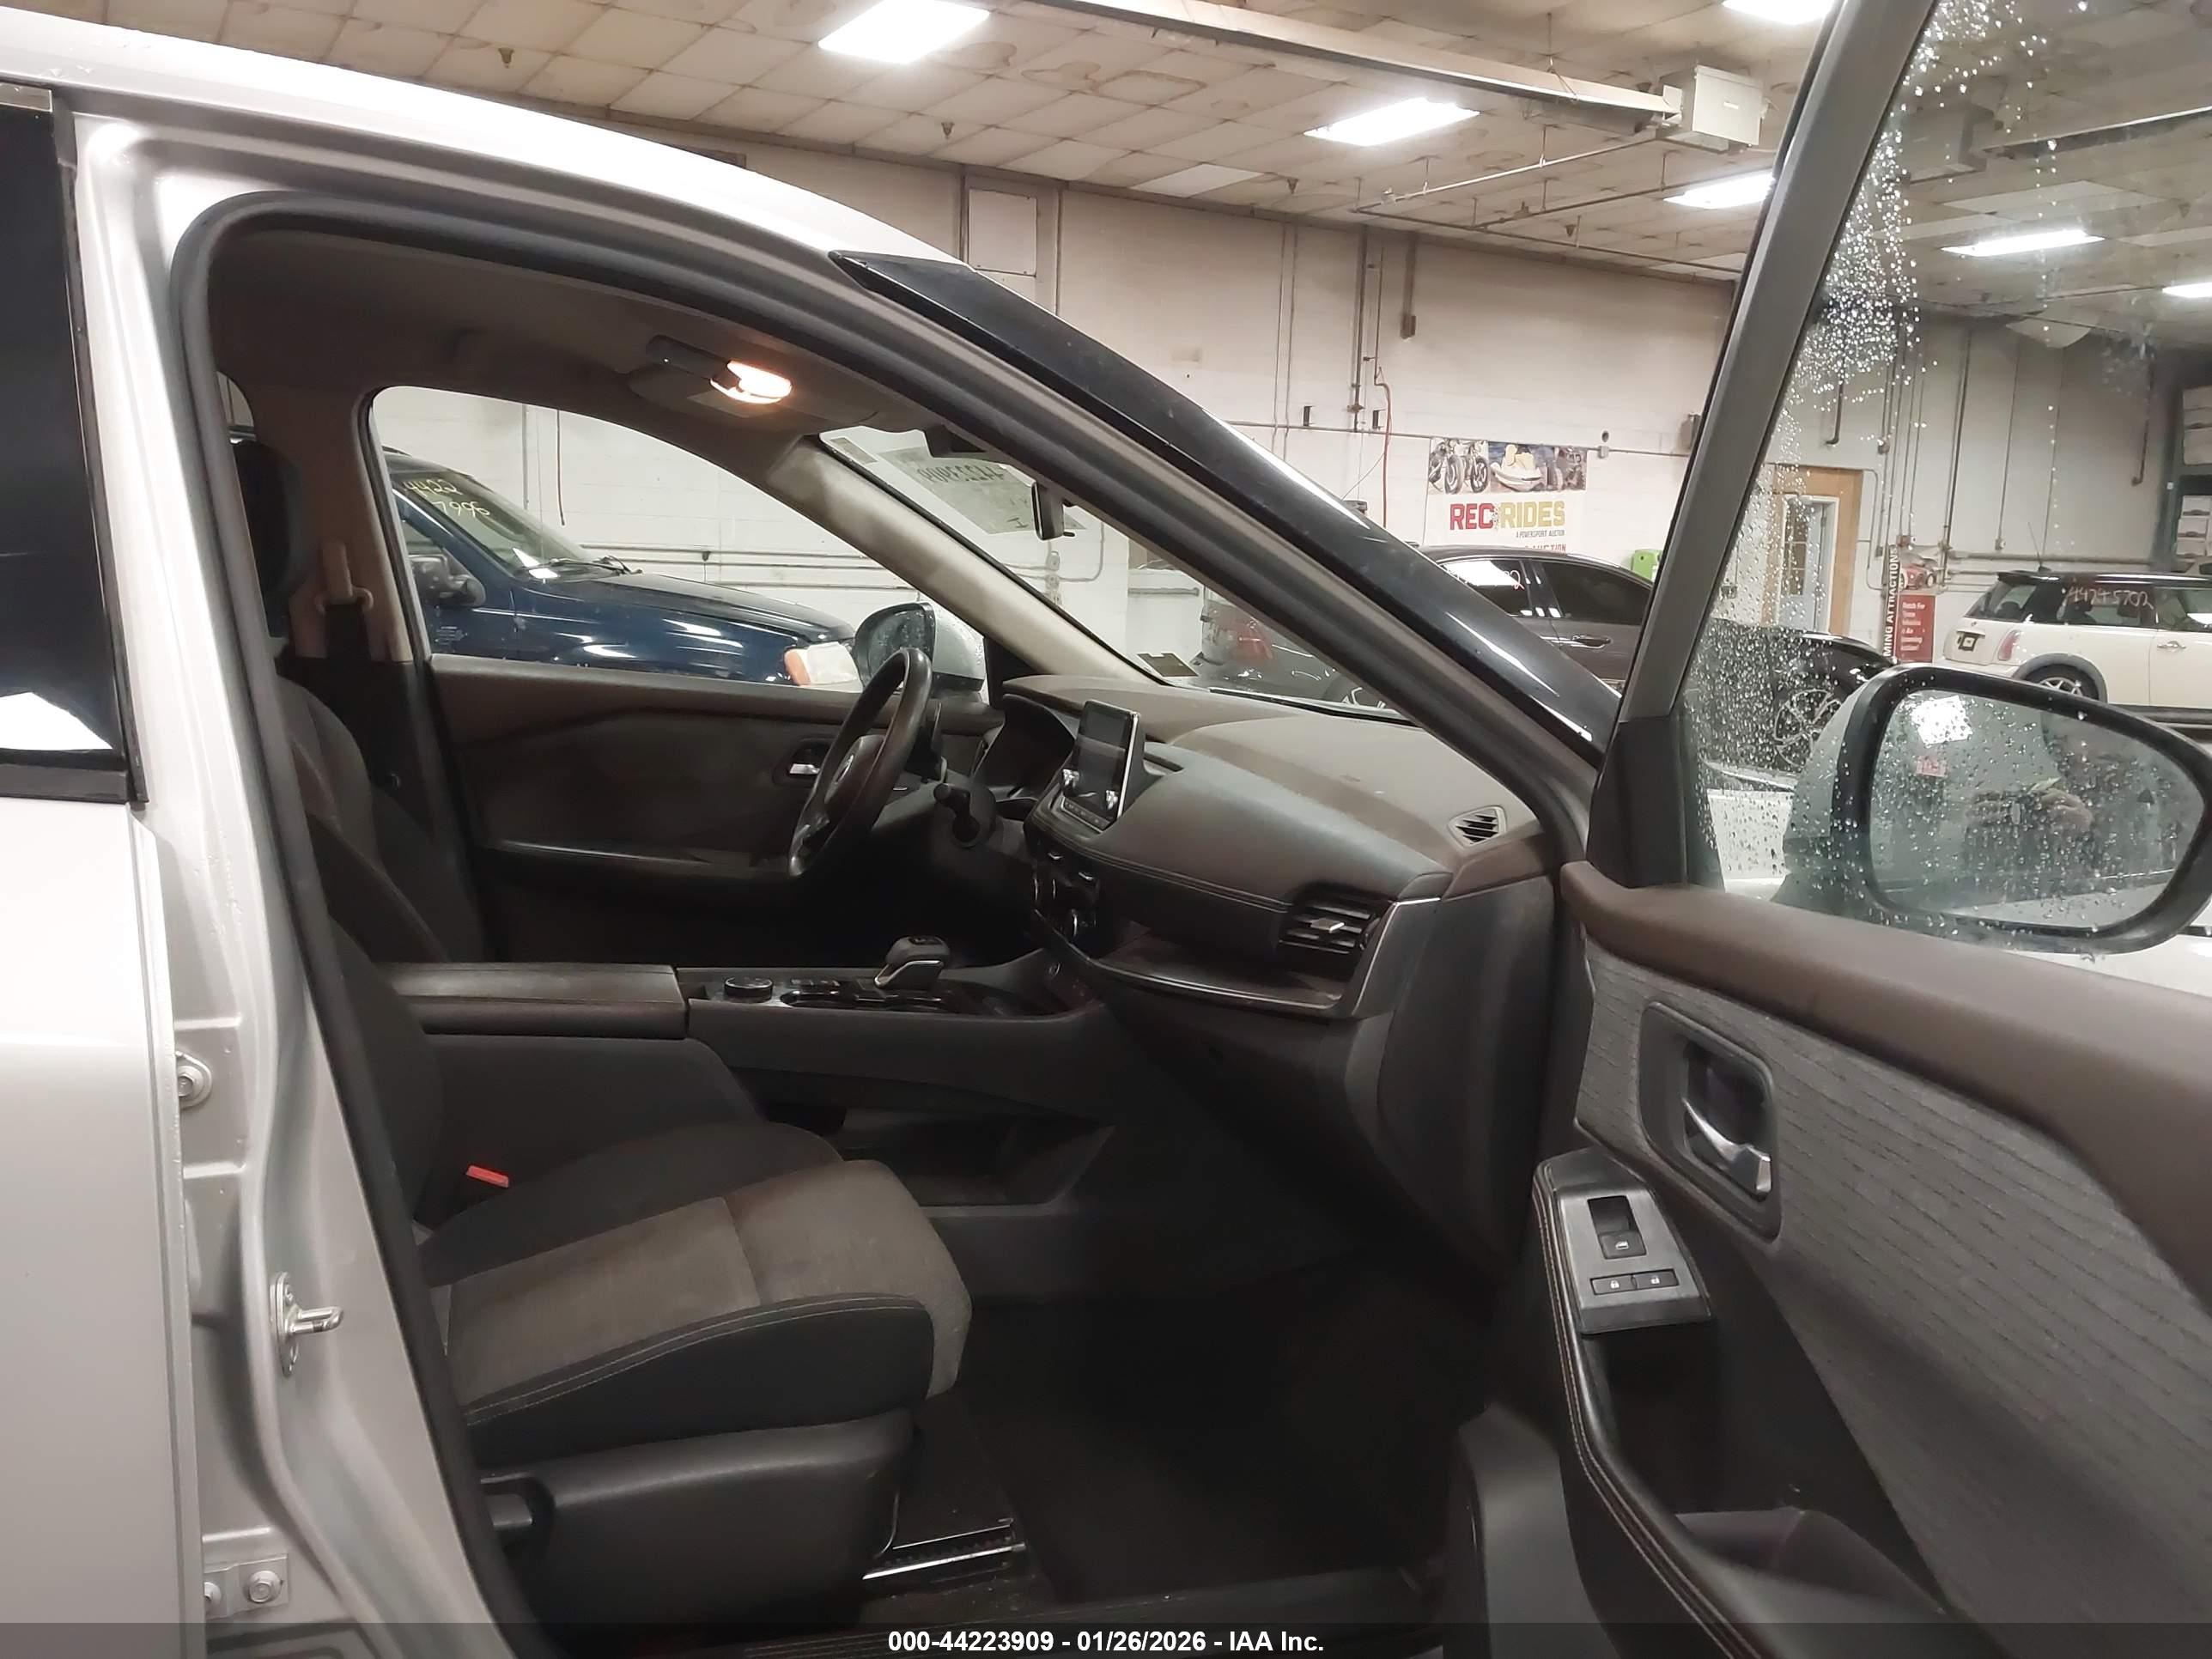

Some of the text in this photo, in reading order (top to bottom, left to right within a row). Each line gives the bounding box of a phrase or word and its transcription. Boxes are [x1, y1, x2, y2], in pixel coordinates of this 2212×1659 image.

[403, 479, 464, 497] 4422
[431, 501, 490, 517] 7996
[1450, 501, 1565, 530] REC RIDES
